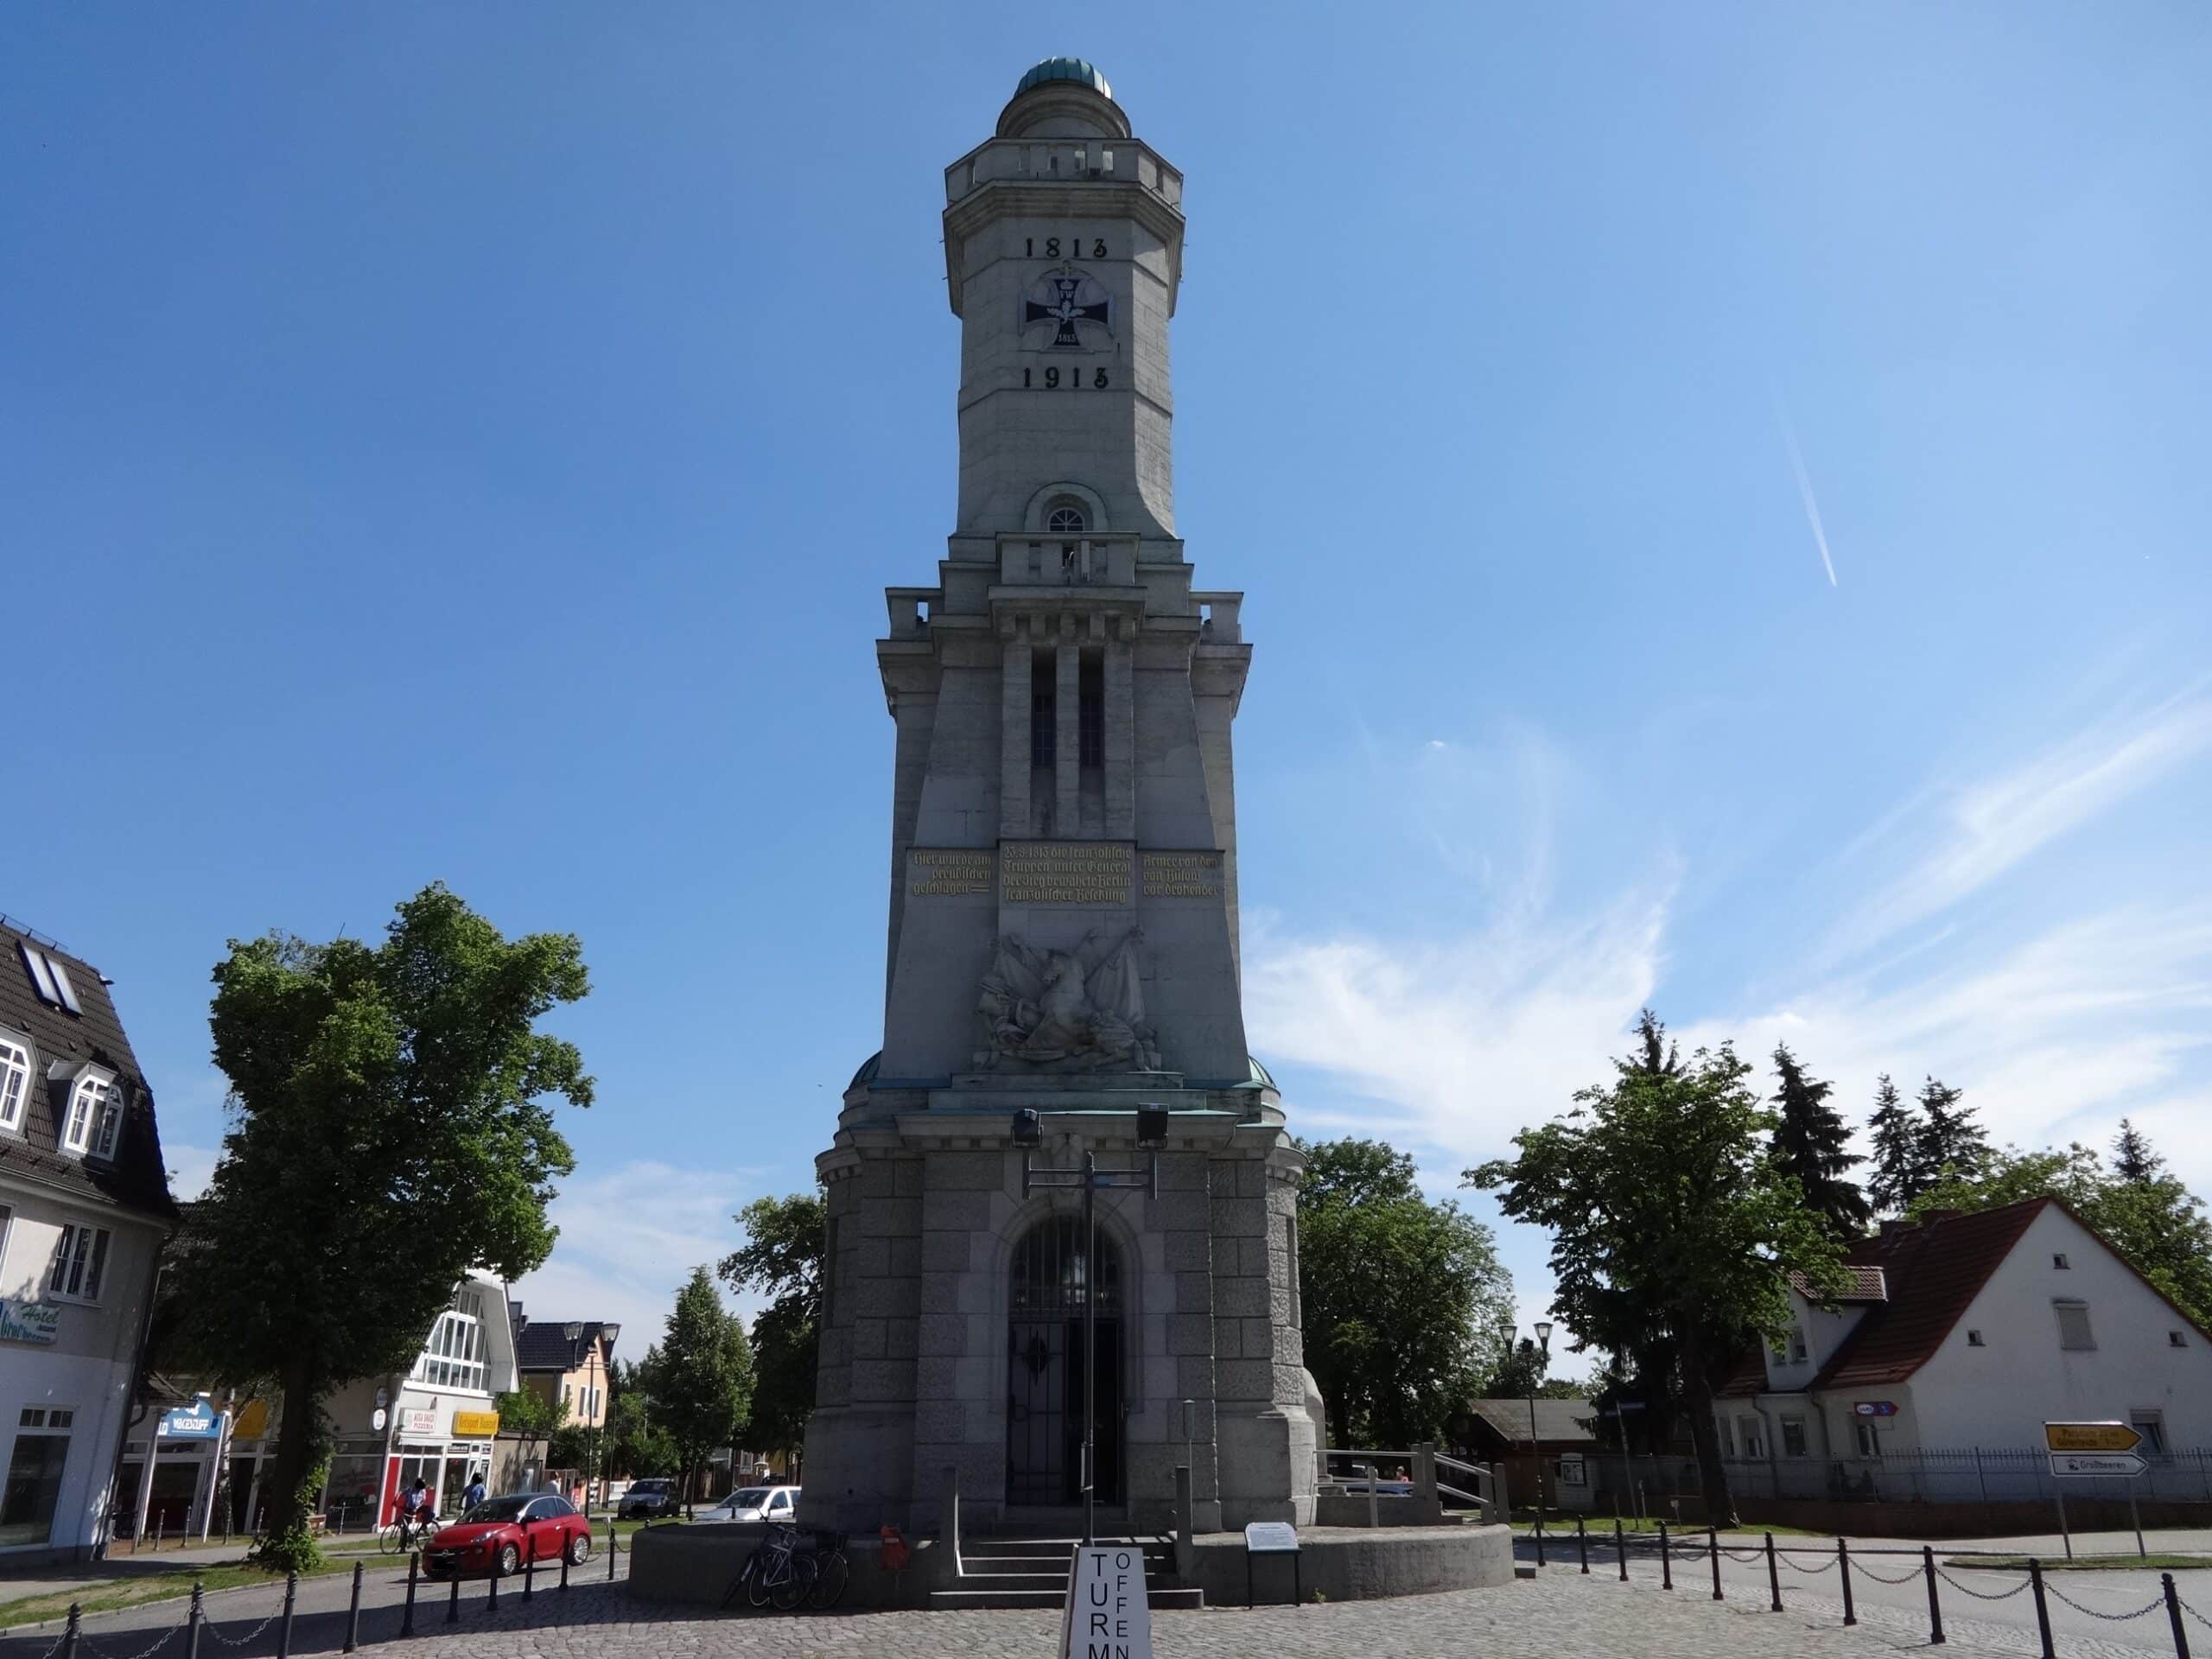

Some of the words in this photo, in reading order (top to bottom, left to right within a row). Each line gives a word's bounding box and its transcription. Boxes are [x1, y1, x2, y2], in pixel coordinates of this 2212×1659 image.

[1026, 238, 1107, 257] 1813
[1024, 366, 1109, 389] 1913
[1003, 860, 1049, 873] Truppen
[1054, 861, 1084, 873] unter
[1087, 860, 1130, 873] General
[1179, 856, 1197, 868] von
[1097, 874, 1131, 887] Berlin
[1143, 870, 1162, 881] von
[913, 880, 968, 895] geschlagen
[1143, 884, 1162, 895] vor
[21, 1305, 59, 1323] Hotel
[1089, 1554, 1109, 1659] TURM
[1116, 1553, 1131, 1659] OFFEN
